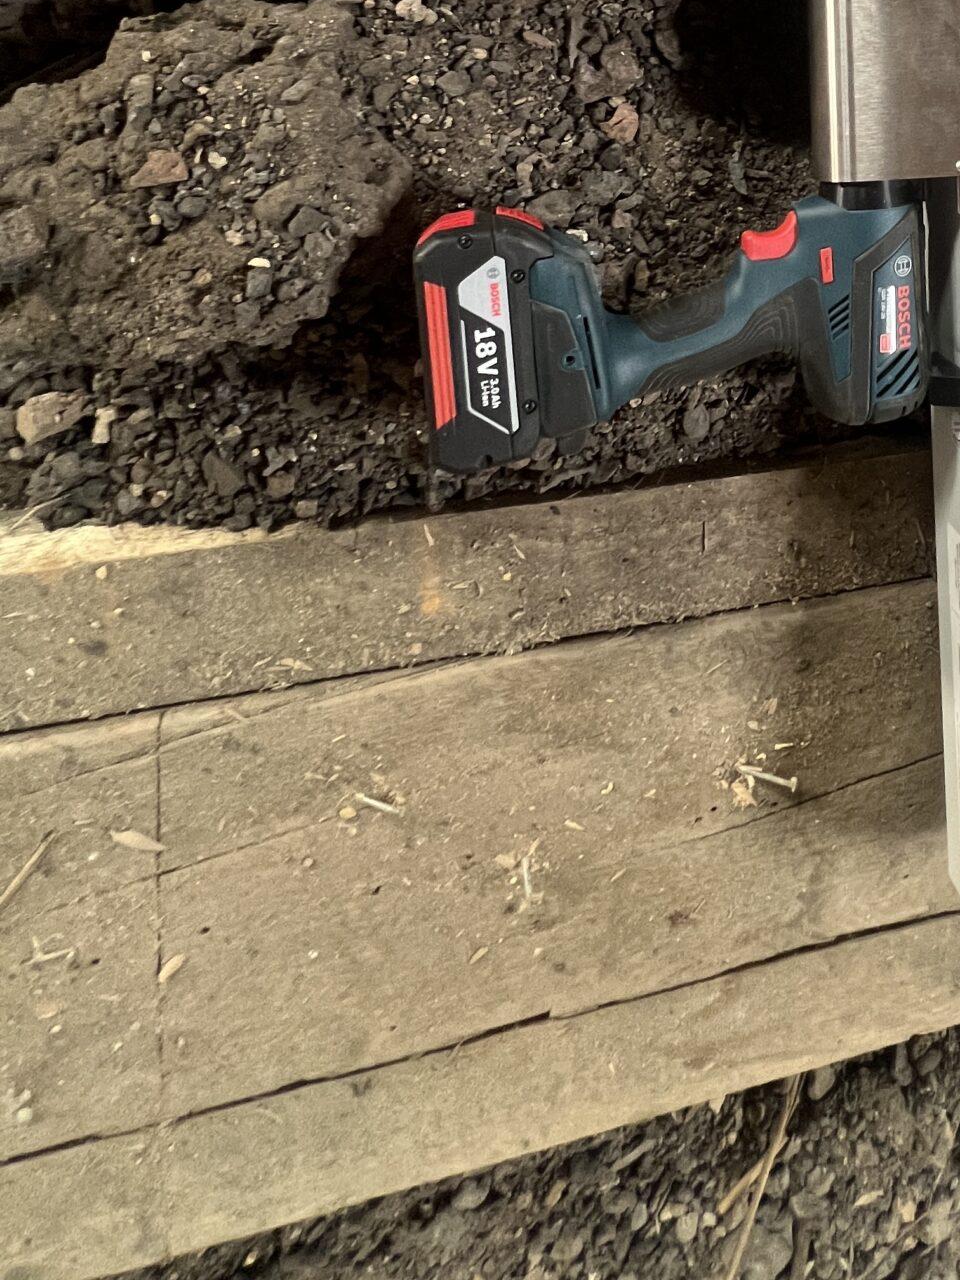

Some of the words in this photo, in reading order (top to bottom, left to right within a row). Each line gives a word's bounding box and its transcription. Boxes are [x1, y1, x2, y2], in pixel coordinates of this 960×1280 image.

[488, 282, 501, 318] BOSCH
[897, 284, 912, 350] BOSCH
[474, 327, 499, 376] 18V
